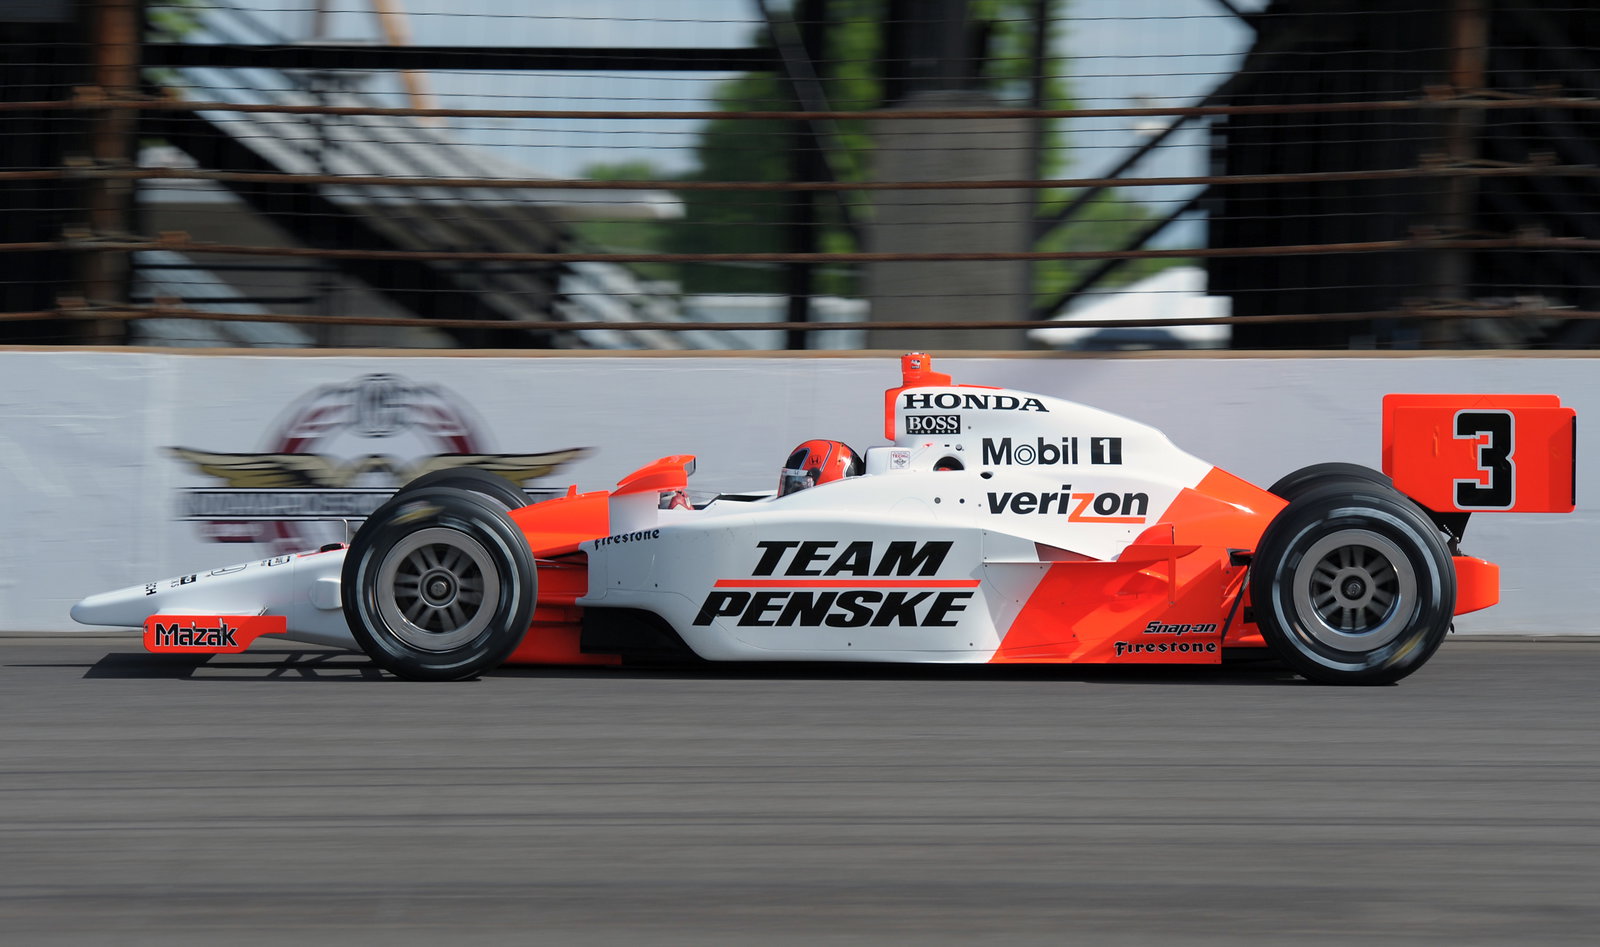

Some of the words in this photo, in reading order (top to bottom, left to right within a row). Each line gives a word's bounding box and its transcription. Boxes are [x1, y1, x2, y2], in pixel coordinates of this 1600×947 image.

[903, 393, 1050, 412] HONDA
[908, 415, 958, 430] BOSS
[982, 437, 1078, 465] Mobil
[1453, 409, 1515, 510] 3
[987, 484, 1149, 524] verizon
[752, 541, 954, 576] TEAM
[692, 591, 974, 628] PENSKE
[155, 623, 239, 647] Mazak
[1143, 621, 1217, 636] Snap-on
[1114, 641, 1217, 657] Firestone
